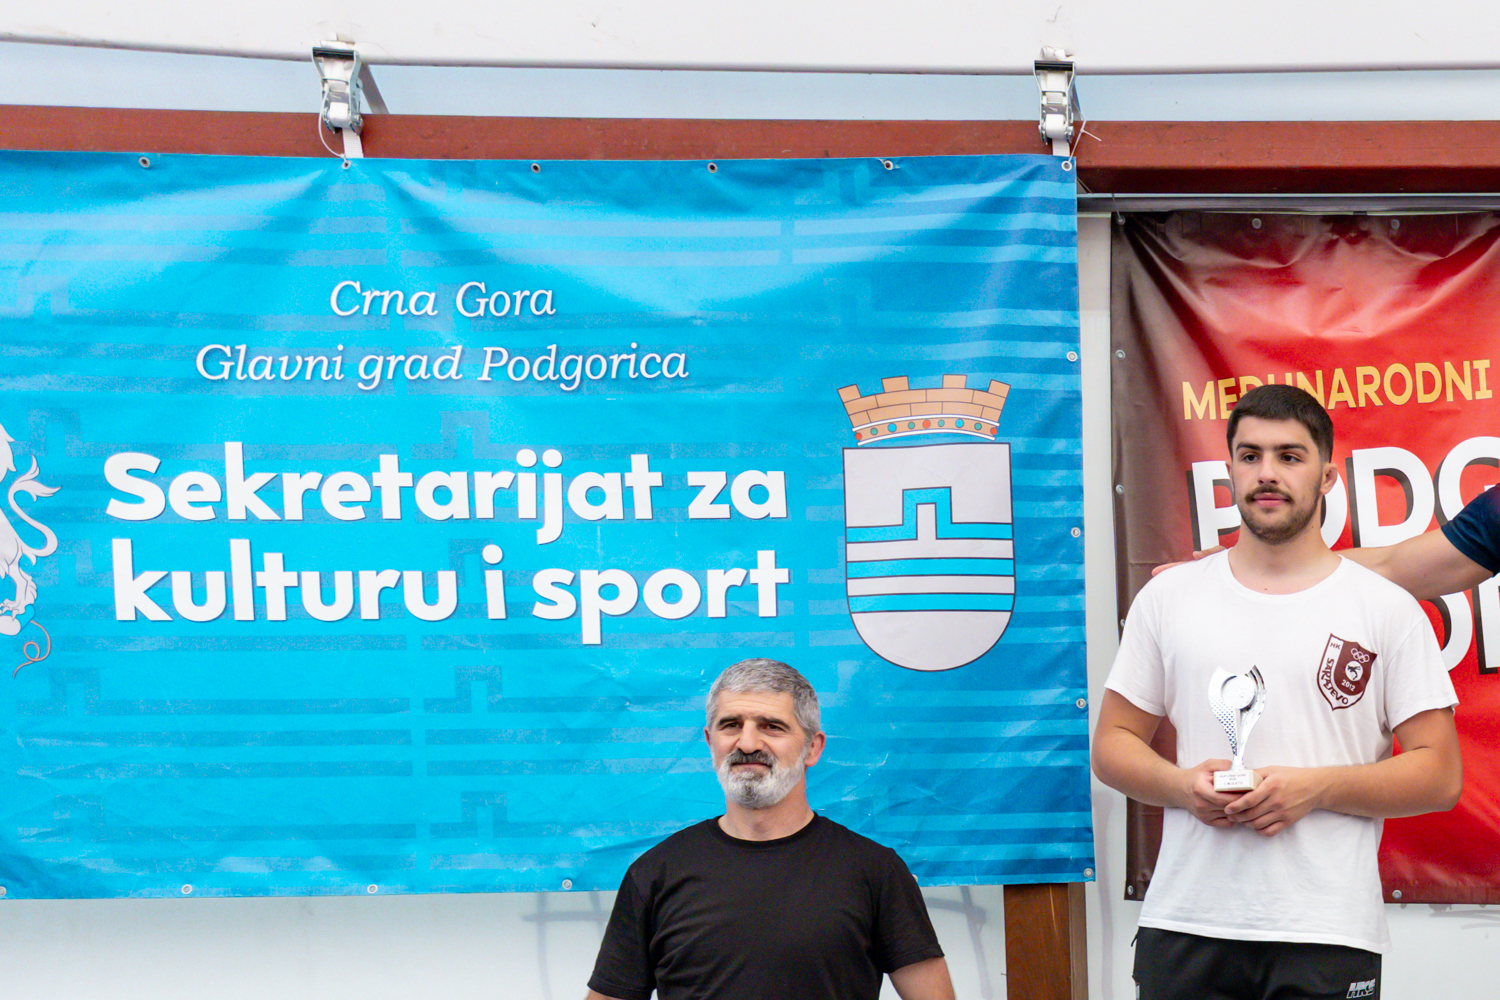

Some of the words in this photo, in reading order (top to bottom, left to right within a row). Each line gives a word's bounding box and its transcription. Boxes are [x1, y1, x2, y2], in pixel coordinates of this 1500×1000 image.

[330, 281, 438, 317] Crna
[455, 281, 556, 318] Gora
[196, 344, 345, 381] Glavni
[357, 344, 463, 391] grad
[477, 342, 689, 391] Podgorica
[103, 441, 663, 545] Sekretarijat
[687, 468, 788, 520] za
[112, 538, 459, 622] kulturu
[482, 544, 506, 619] i
[531, 549, 790, 645] sport
[1329, 642, 1342, 650] HK
[1320, 657, 1349, 705] SARAJEVO
[1341, 679, 1355, 691] 2012
